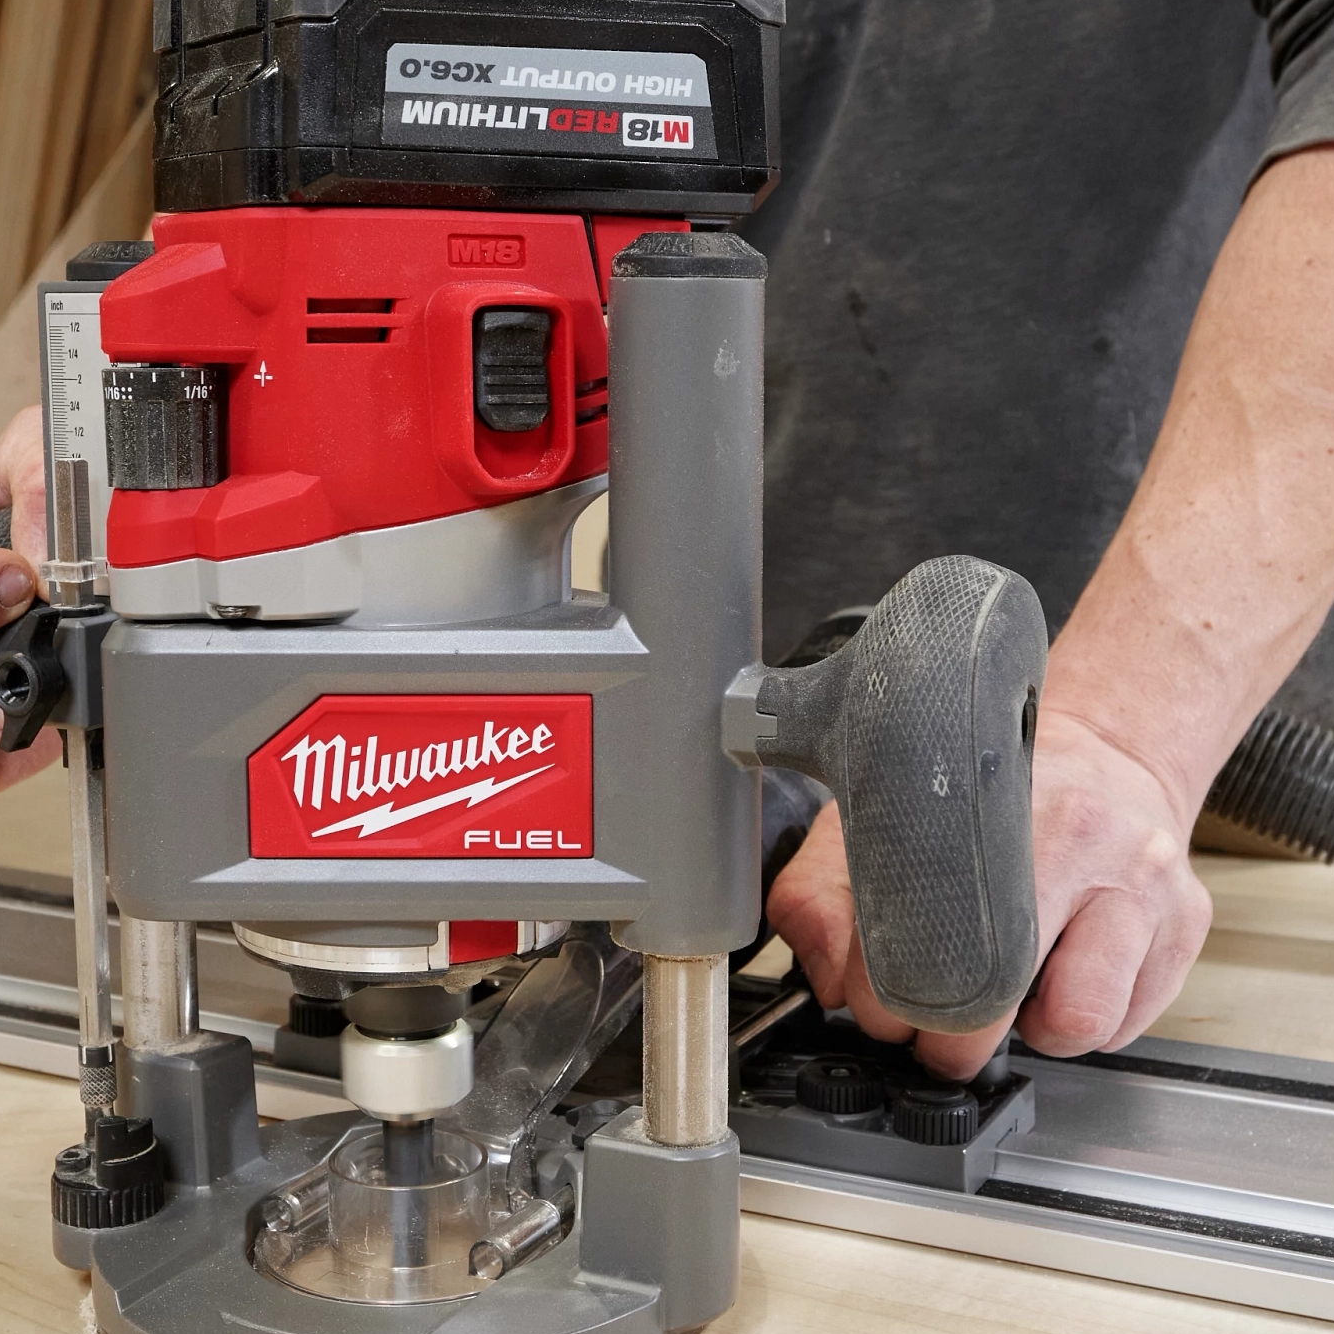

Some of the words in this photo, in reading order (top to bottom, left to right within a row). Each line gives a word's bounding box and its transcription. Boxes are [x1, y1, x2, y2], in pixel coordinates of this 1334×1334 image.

[399, 58, 496, 83] XC6.0
[499, 66, 617, 93] OUTPUT
[623, 73, 693, 98] HIGH
[627, 118, 689, 143] M18
[451, 239, 521, 264] M18
[50, 301, 64, 310] inch
[70, 322, 80, 332] 1/2
[68, 349, 78, 358] 1/4
[77, 374, 82, 384] 2
[69, 401, 80, 411] 3/4
[74, 427, 84, 436] 1/2
[281, 721, 556, 811] Milwaukee
[464, 830, 582, 850] FUEL
